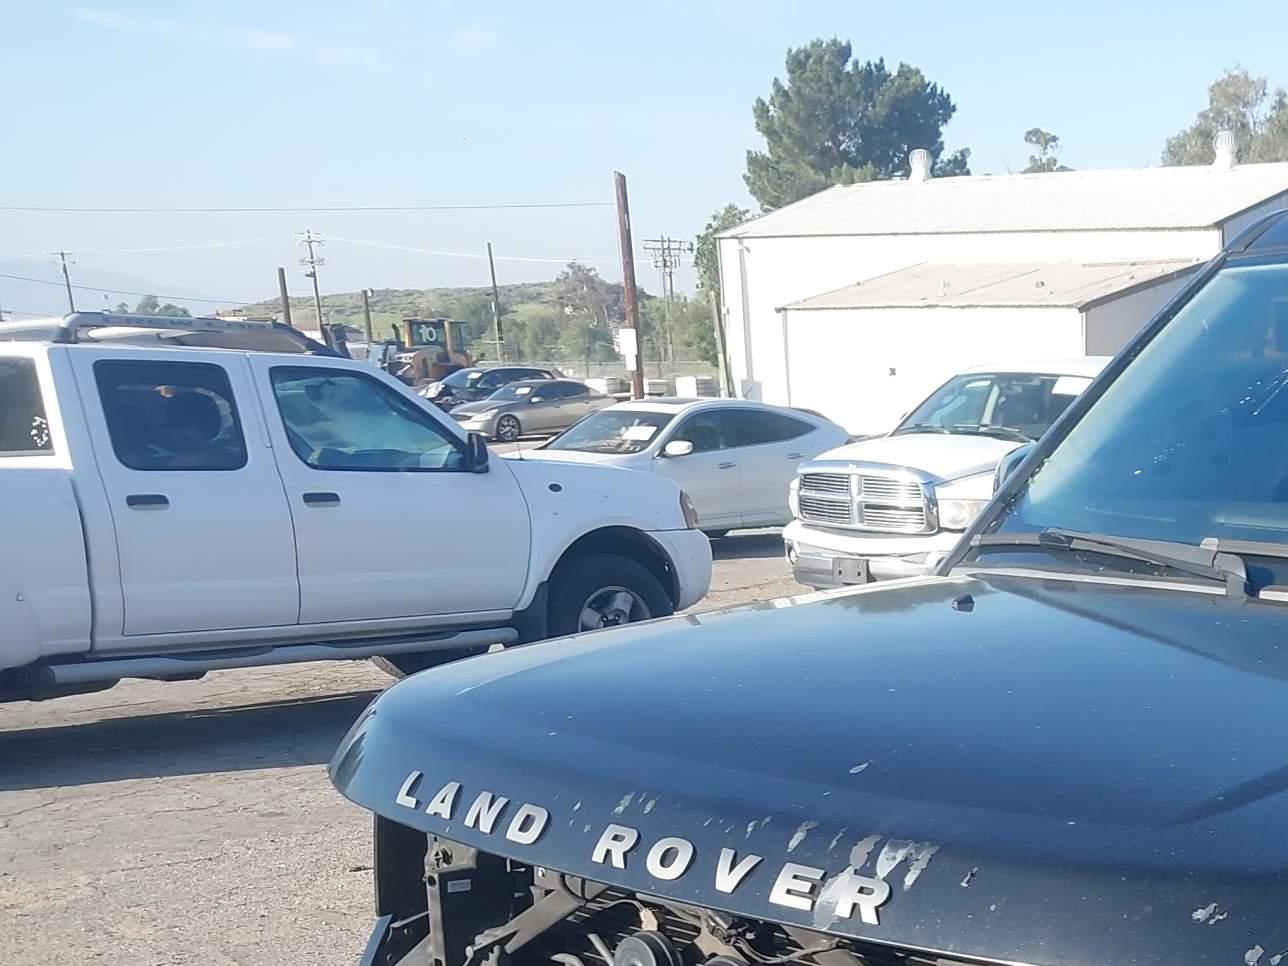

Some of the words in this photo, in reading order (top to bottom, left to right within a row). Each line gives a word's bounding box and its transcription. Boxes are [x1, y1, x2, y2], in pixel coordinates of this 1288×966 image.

[418, 324, 437, 343] 10
[396, 769, 550, 845] LAND
[591, 823, 892, 925] ROVER
